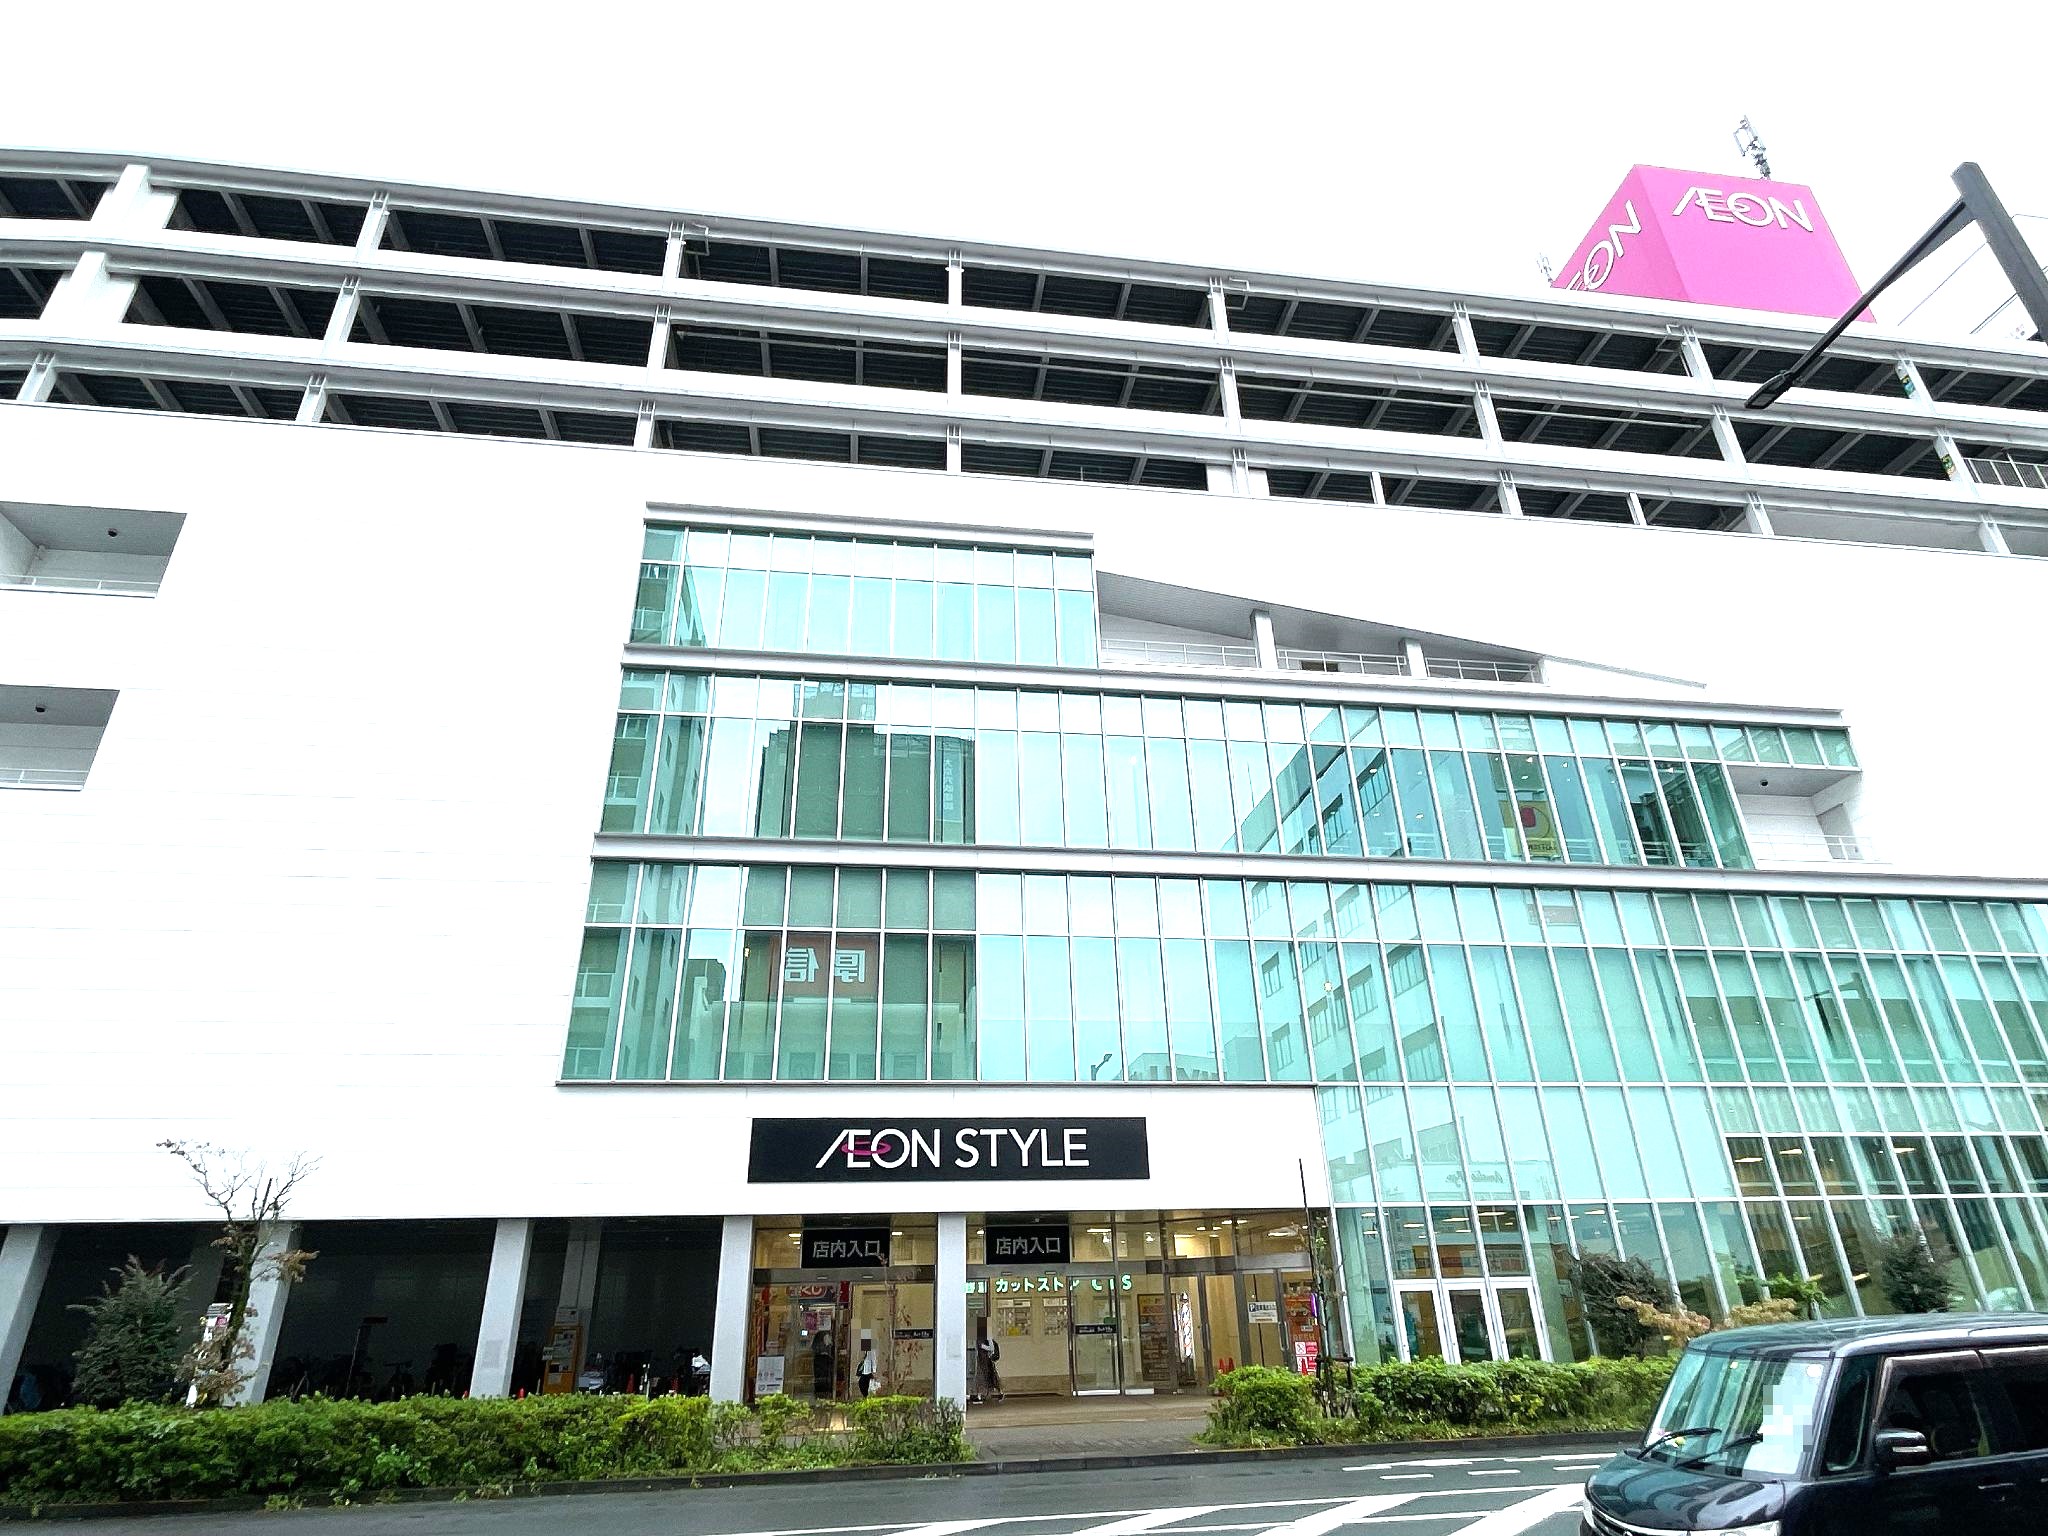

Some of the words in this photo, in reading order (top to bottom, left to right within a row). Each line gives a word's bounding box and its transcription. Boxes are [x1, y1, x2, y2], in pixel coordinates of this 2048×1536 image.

[955, 1127, 1090, 1169] STYLE
[812, 1240, 881, 1258] 店内入口
[996, 1236, 1062, 1255] 店内入口
